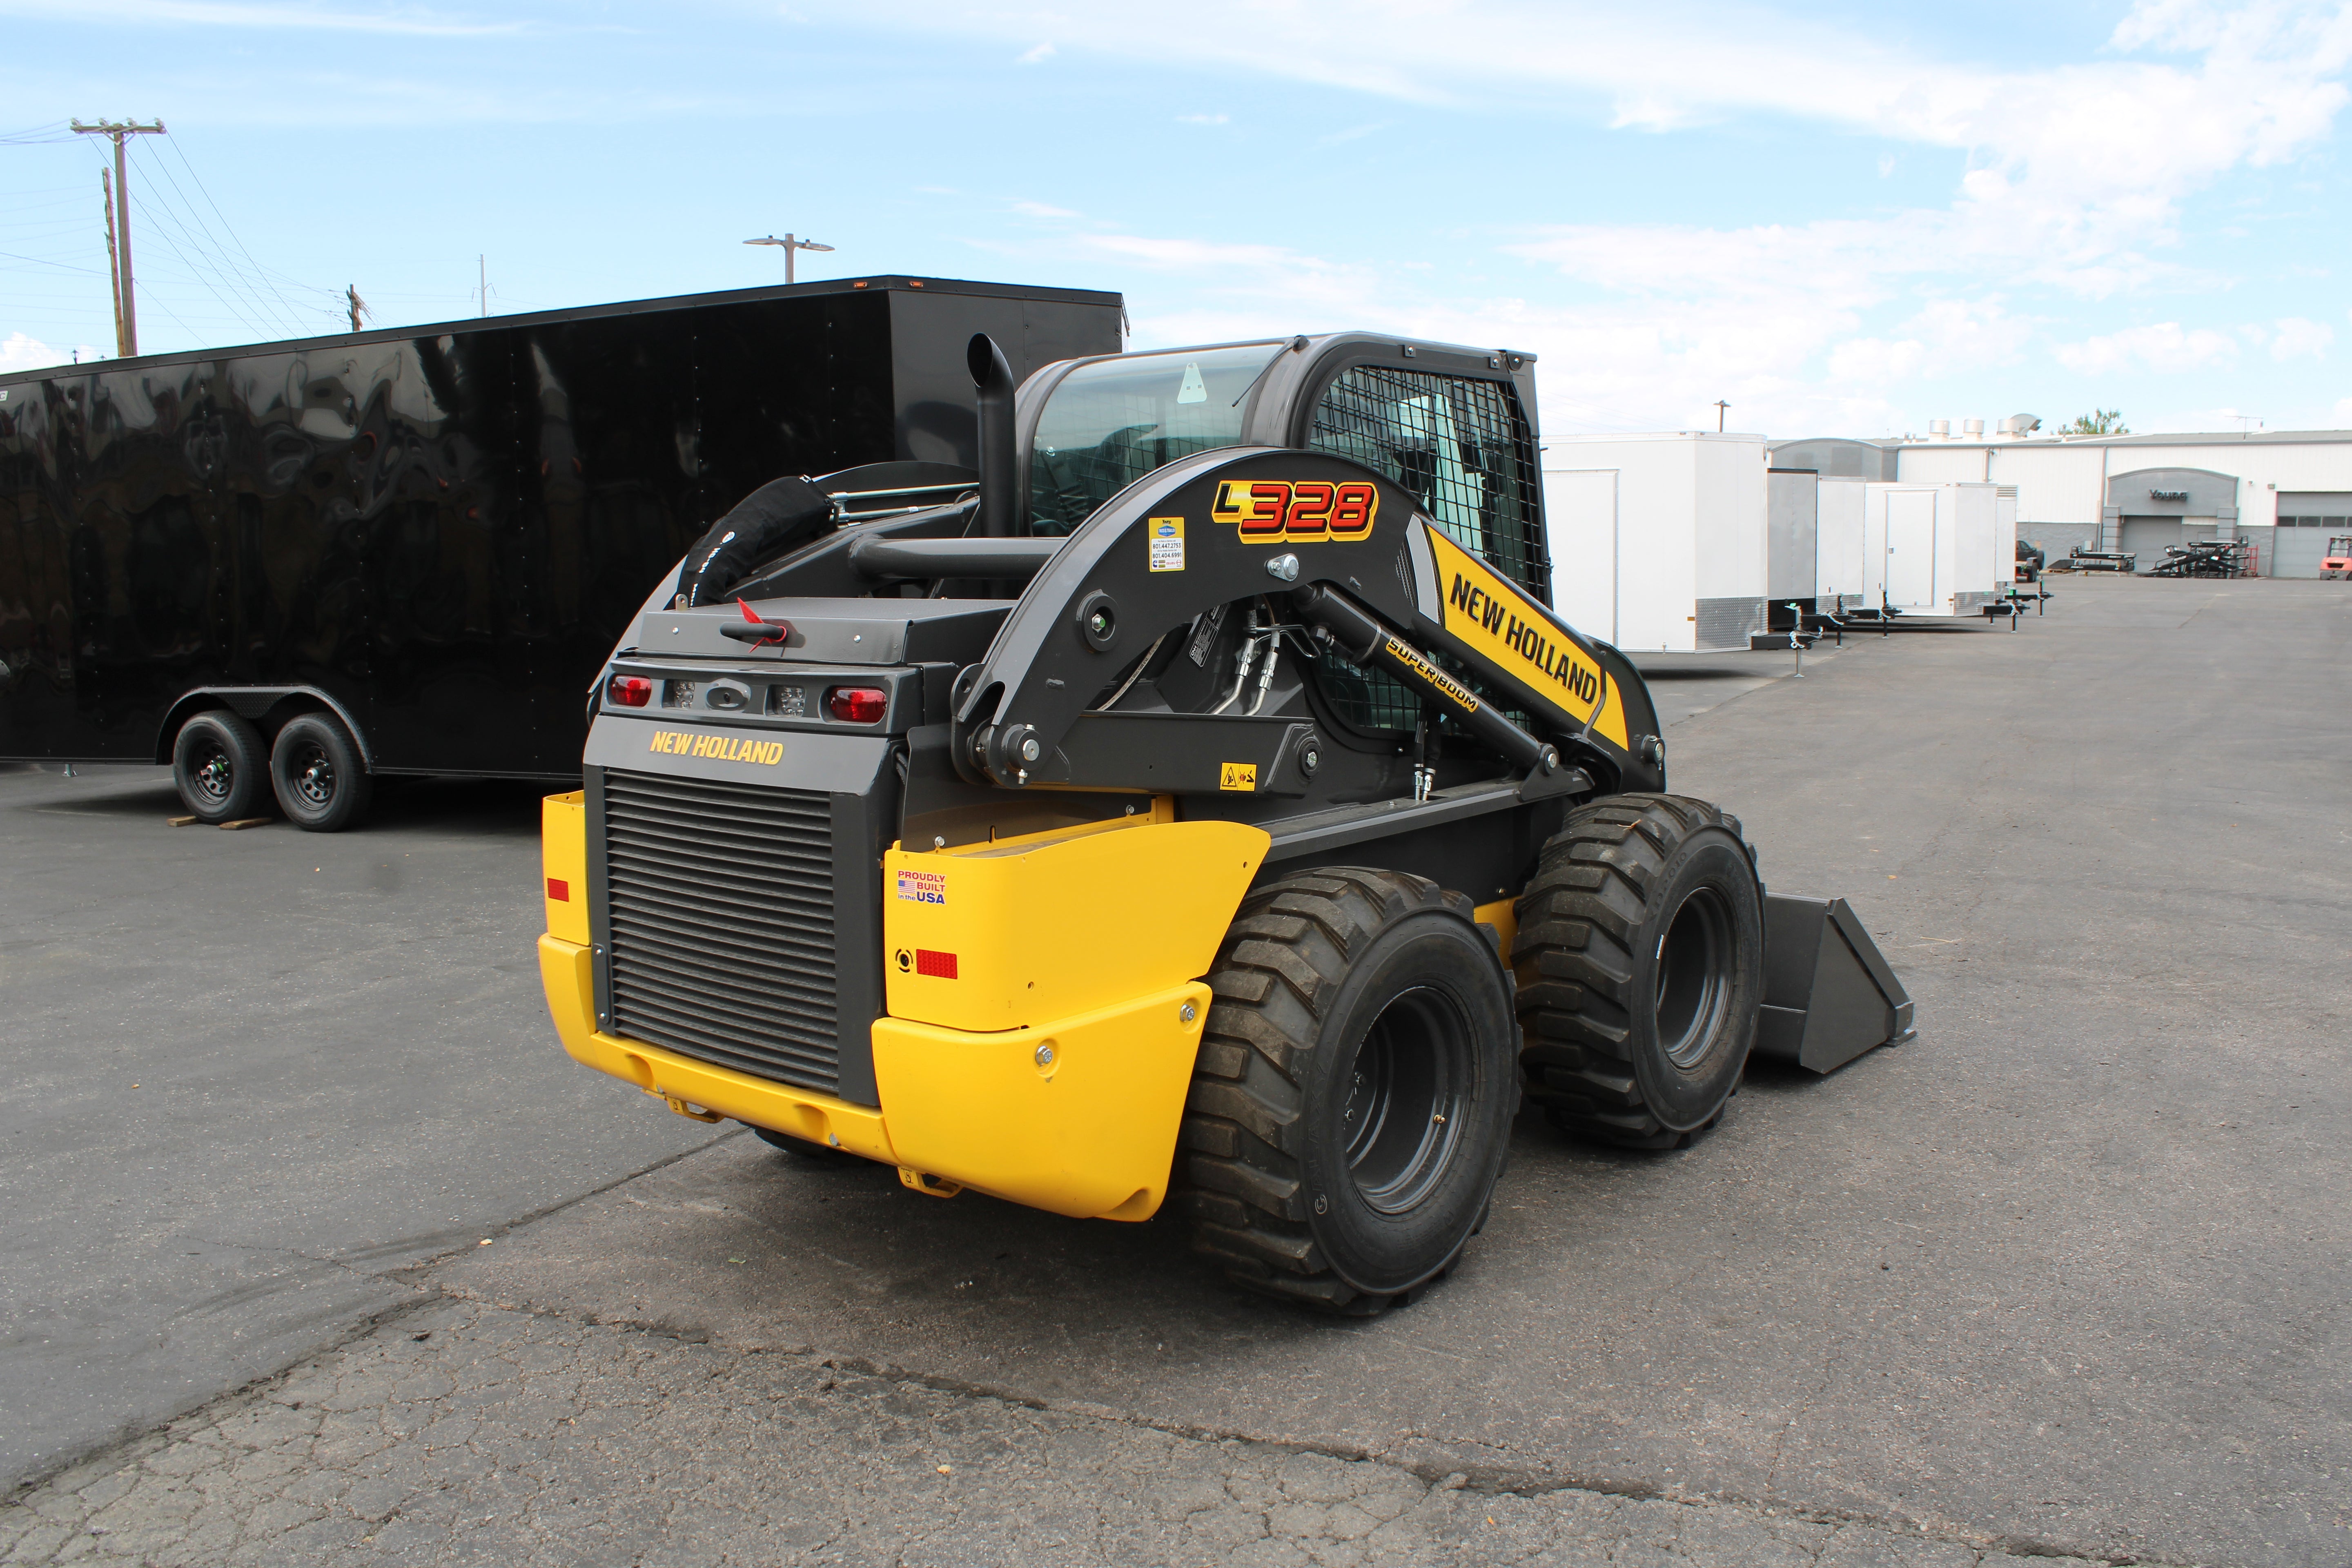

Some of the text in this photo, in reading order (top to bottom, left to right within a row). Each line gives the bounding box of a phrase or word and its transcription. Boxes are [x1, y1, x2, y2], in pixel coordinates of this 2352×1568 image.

[1214, 482, 1375, 535] L328
[2149, 489, 2188, 501] Young
[1449, 572, 1597, 705] NEW HOLLAND
[1388, 638, 1478, 710] SUPER BOOM
[650, 731, 784, 765] NEW HOLLAND
[898, 870, 945, 882] PROUDLY
[917, 882, 945, 892] BUILT
[917, 891, 945, 904] USA
[1307, 1064, 1327, 1214] GALAXY
